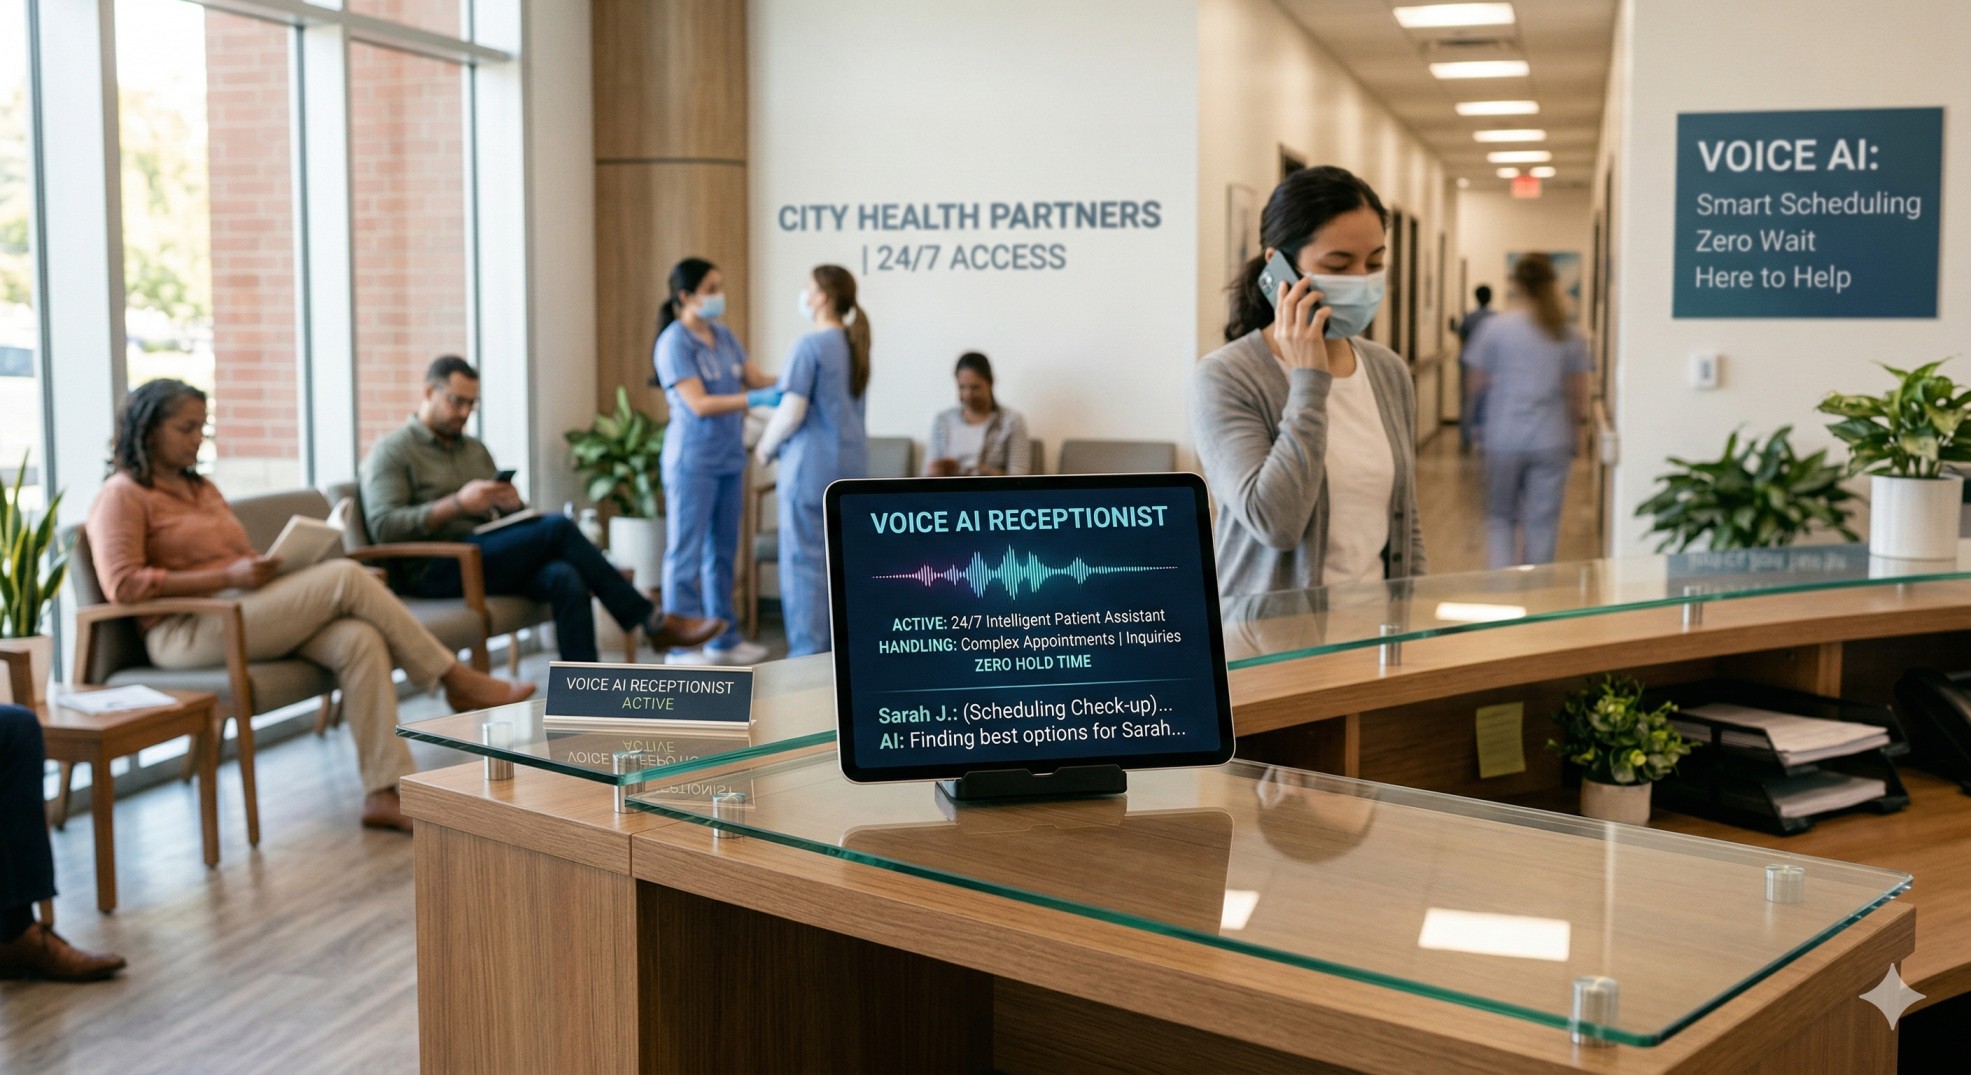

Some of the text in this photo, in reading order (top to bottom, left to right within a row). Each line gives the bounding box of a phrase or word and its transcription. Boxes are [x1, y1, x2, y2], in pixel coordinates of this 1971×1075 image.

[1697, 138, 1879, 172] VOICE AI:
[778, 200, 1162, 231] CITY HEALTH PARTNERS
[1697, 190, 1922, 220] Smart Scheduling
[1696, 229, 1816, 252] Zero Wait
[877, 244, 941, 271] 24/7
[949, 243, 1067, 270] ACCESS
[1695, 264, 1852, 294] Here to Help
[870, 505, 1168, 534] VOICE AI RECEPTIONIST
[892, 609, 1166, 632] ACTIVE: 24/7 Intelligent Patient Assistant
[879, 638, 958, 654] HANDLING:
[961, 635, 1019, 652] Complex
[1023, 632, 1115, 651] Appointments
[1126, 629, 1182, 647] Inquiries
[975, 654, 1092, 672] ZERO HOLD TIME
[567, 677, 735, 695] VOICE AI RECEPTIONIST
[622, 697, 674, 711] ACTIVE
[878, 694, 1173, 725] Sarah J.: (Scheduling Check-up)...
[879, 719, 1186, 750] AI: Finding best options for Sarah...
